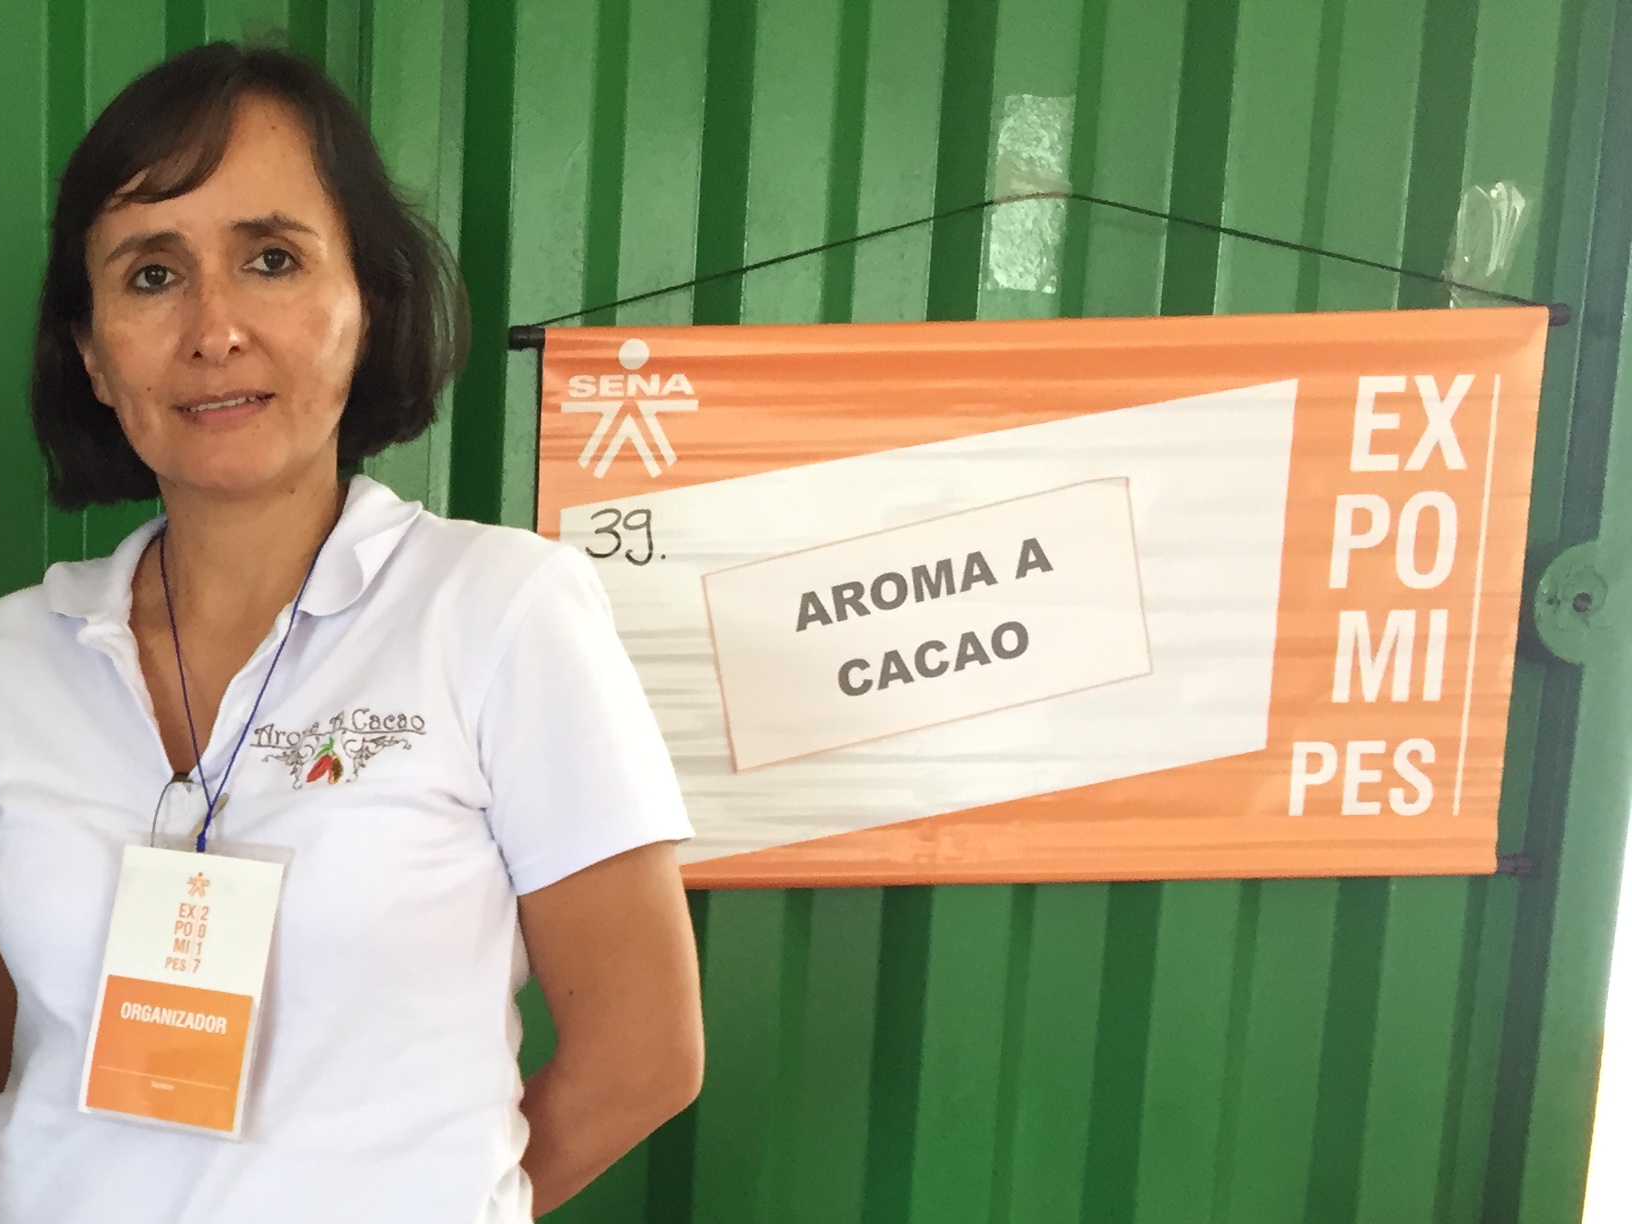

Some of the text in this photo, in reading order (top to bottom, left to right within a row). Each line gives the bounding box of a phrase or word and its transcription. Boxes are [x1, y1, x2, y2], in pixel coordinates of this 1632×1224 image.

[568, 373, 696, 398] SENA
[1349, 374, 1476, 472] EX
[1329, 490, 1459, 590] PO
[795, 537, 1054, 632] AROMA A
[837, 621, 1029, 697] CACAO
[1331, 608, 1449, 703] MI
[254, 721, 319, 746] Aroa
[352, 708, 426, 731] Cacao
[1288, 737, 1437, 817] PES
[174, 920, 193, 936] PO
[179, 903, 196, 919] EX
[165, 956, 187, 971] PES
[173, 938, 190, 954] MI
[120, 1001, 227, 1035] ORGANIZADOR
